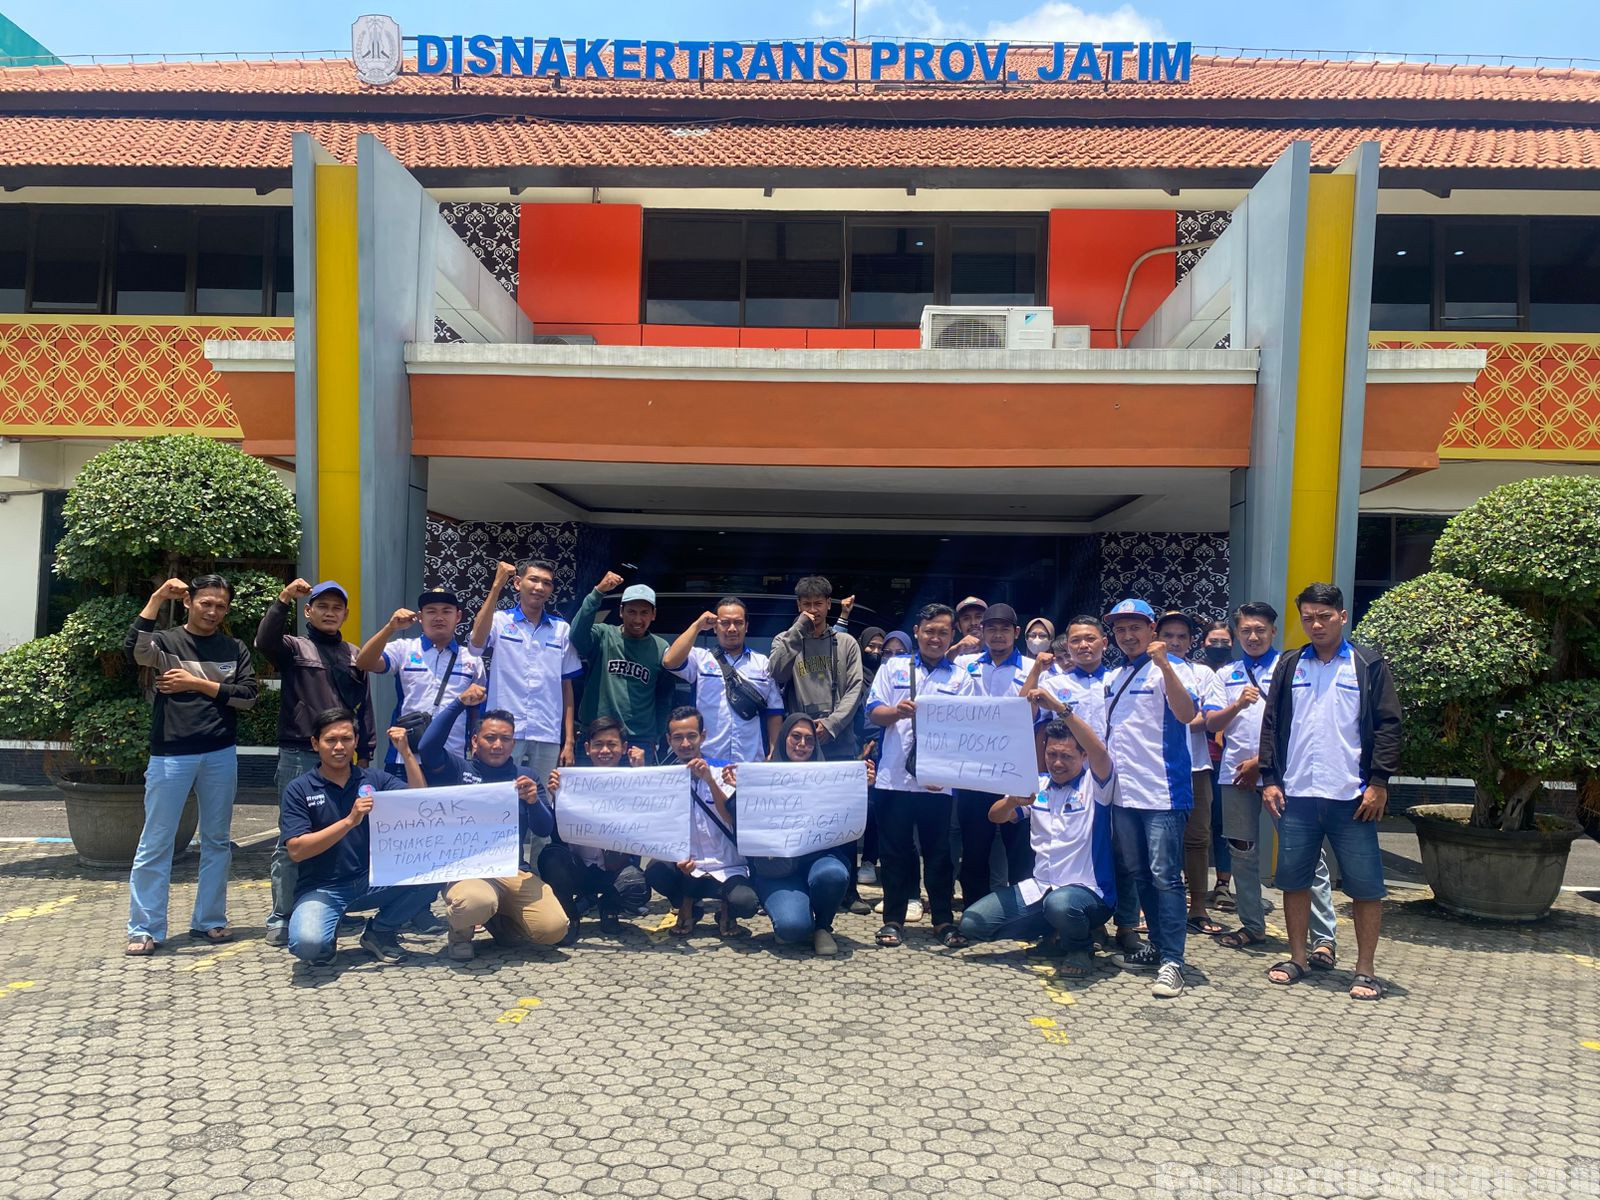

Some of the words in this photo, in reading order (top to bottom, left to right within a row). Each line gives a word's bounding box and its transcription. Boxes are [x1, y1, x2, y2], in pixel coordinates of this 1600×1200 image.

[417, 34, 848, 81] DISNAKERTRANS
[870, 41, 1019, 82] PROV.
[1037, 41, 1193, 83] JATIM
[608, 659, 650, 685] ERIGO
[926, 703, 1001, 723] PERCUMA
[924, 732, 948, 751] ADA
[958, 733, 1010, 752] POSKO
[958, 760, 1023, 778] THR
[563, 775, 653, 793] PENGADUAN
[418, 799, 469, 819] GAK
[376, 817, 446, 834] BAHAYA
